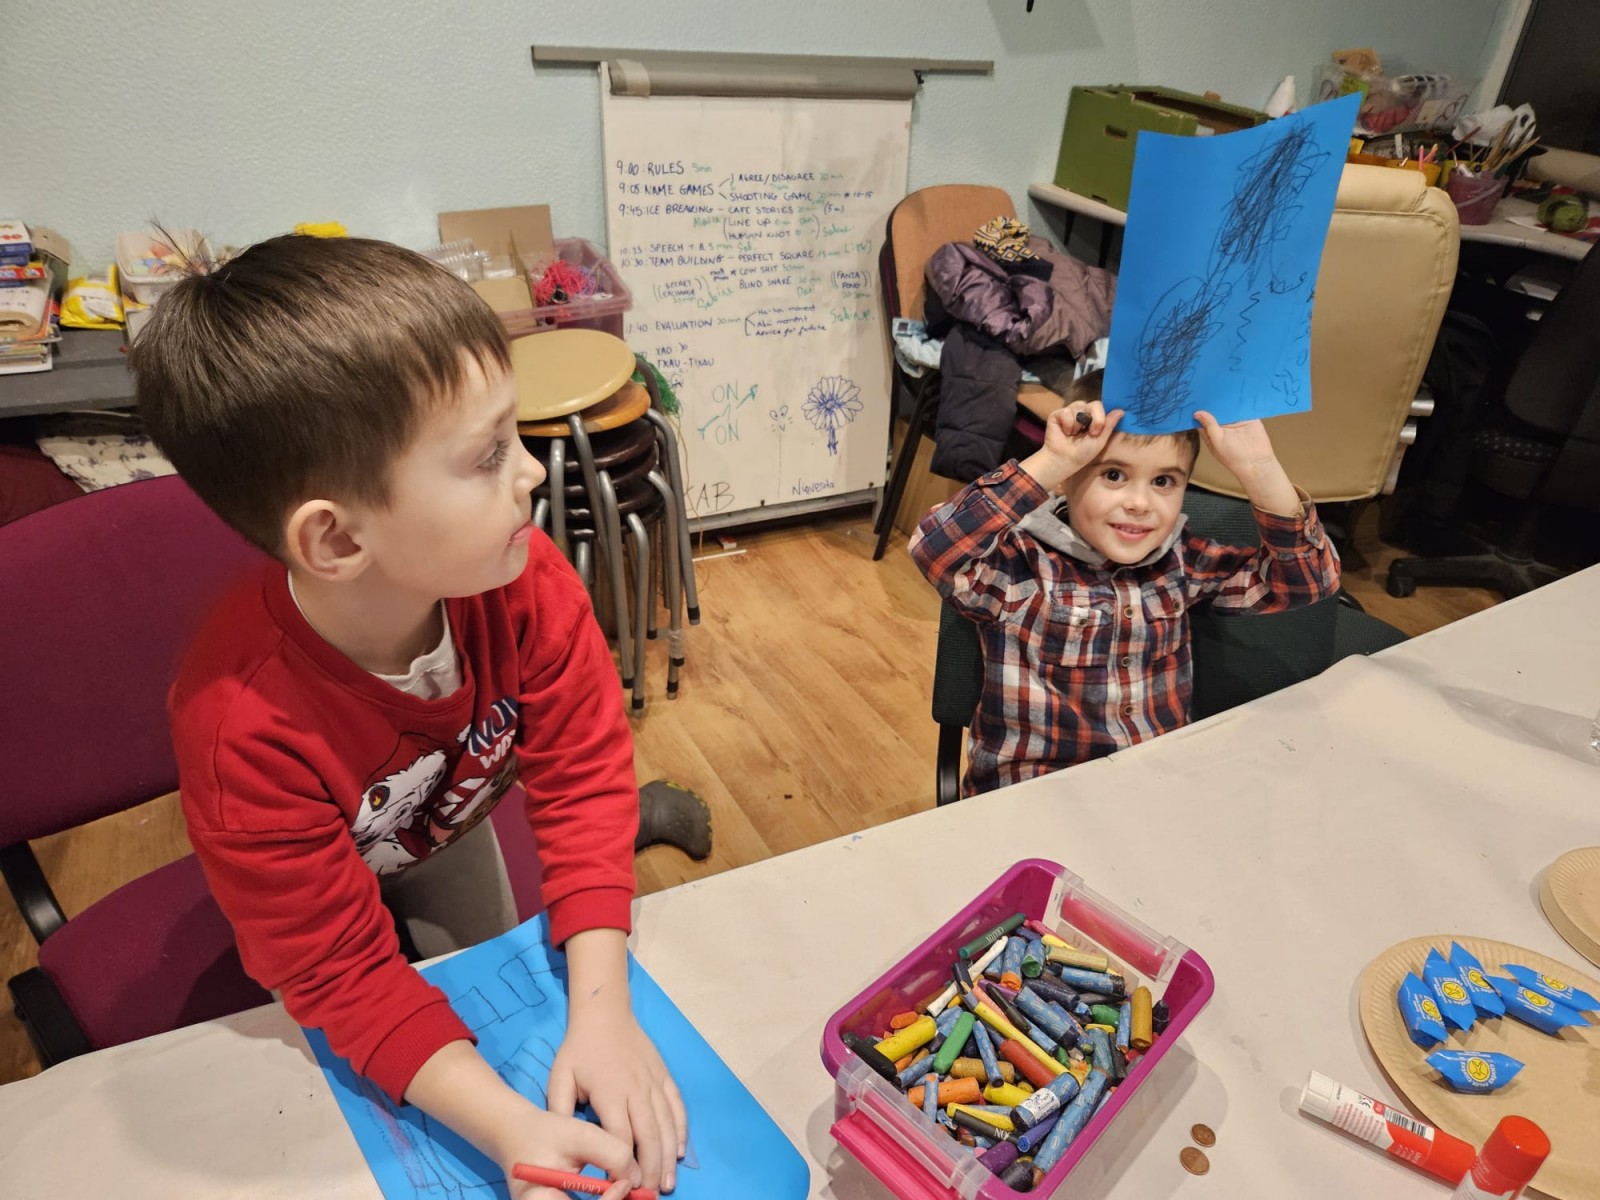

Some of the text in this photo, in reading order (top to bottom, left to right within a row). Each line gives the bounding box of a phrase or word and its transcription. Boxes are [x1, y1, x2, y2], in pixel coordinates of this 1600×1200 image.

[648, 161, 685, 176] RULES
[645, 184, 674, 196] NAME
[680, 184, 714, 196] GAMES
[784, 192, 813, 201] GAME
[665, 204, 714, 214] BREAKING
[656, 318, 713, 331] EVALUATION
